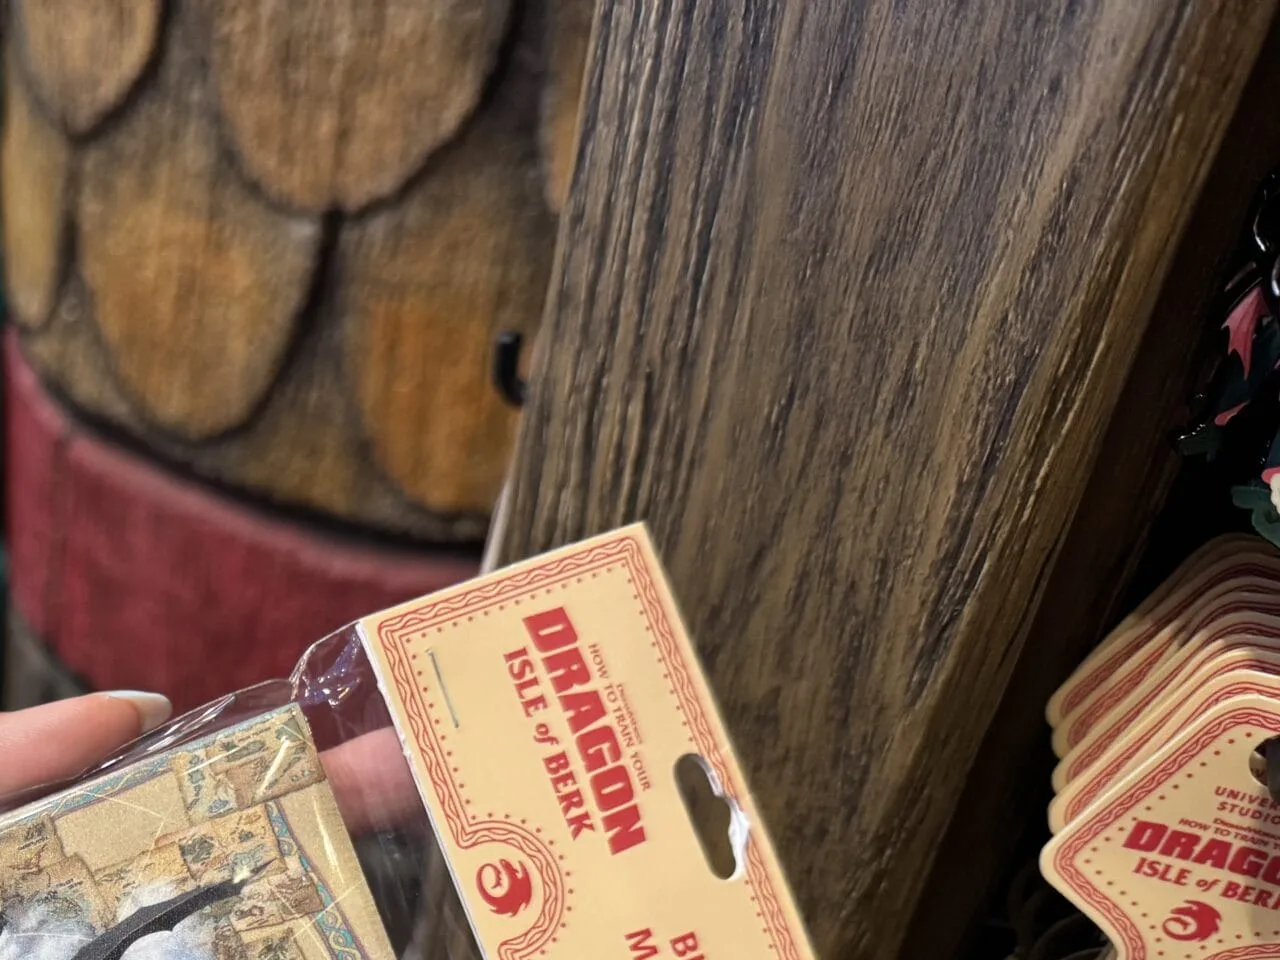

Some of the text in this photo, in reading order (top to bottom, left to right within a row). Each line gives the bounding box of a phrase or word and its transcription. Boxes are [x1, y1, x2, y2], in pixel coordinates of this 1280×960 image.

[503, 646, 595, 841] ISLE of BERK
[522, 606, 646, 855] DRAGON
[588, 643, 651, 791] HOW TO TRAIN YOUR
[1132, 857, 1192, 886] ISLE
[1195, 878, 1221, 892] of
[1178, 817, 1211, 831] HOW
[1213, 827, 1232, 837] TO
[1233, 832, 1270, 847] TRAIN
